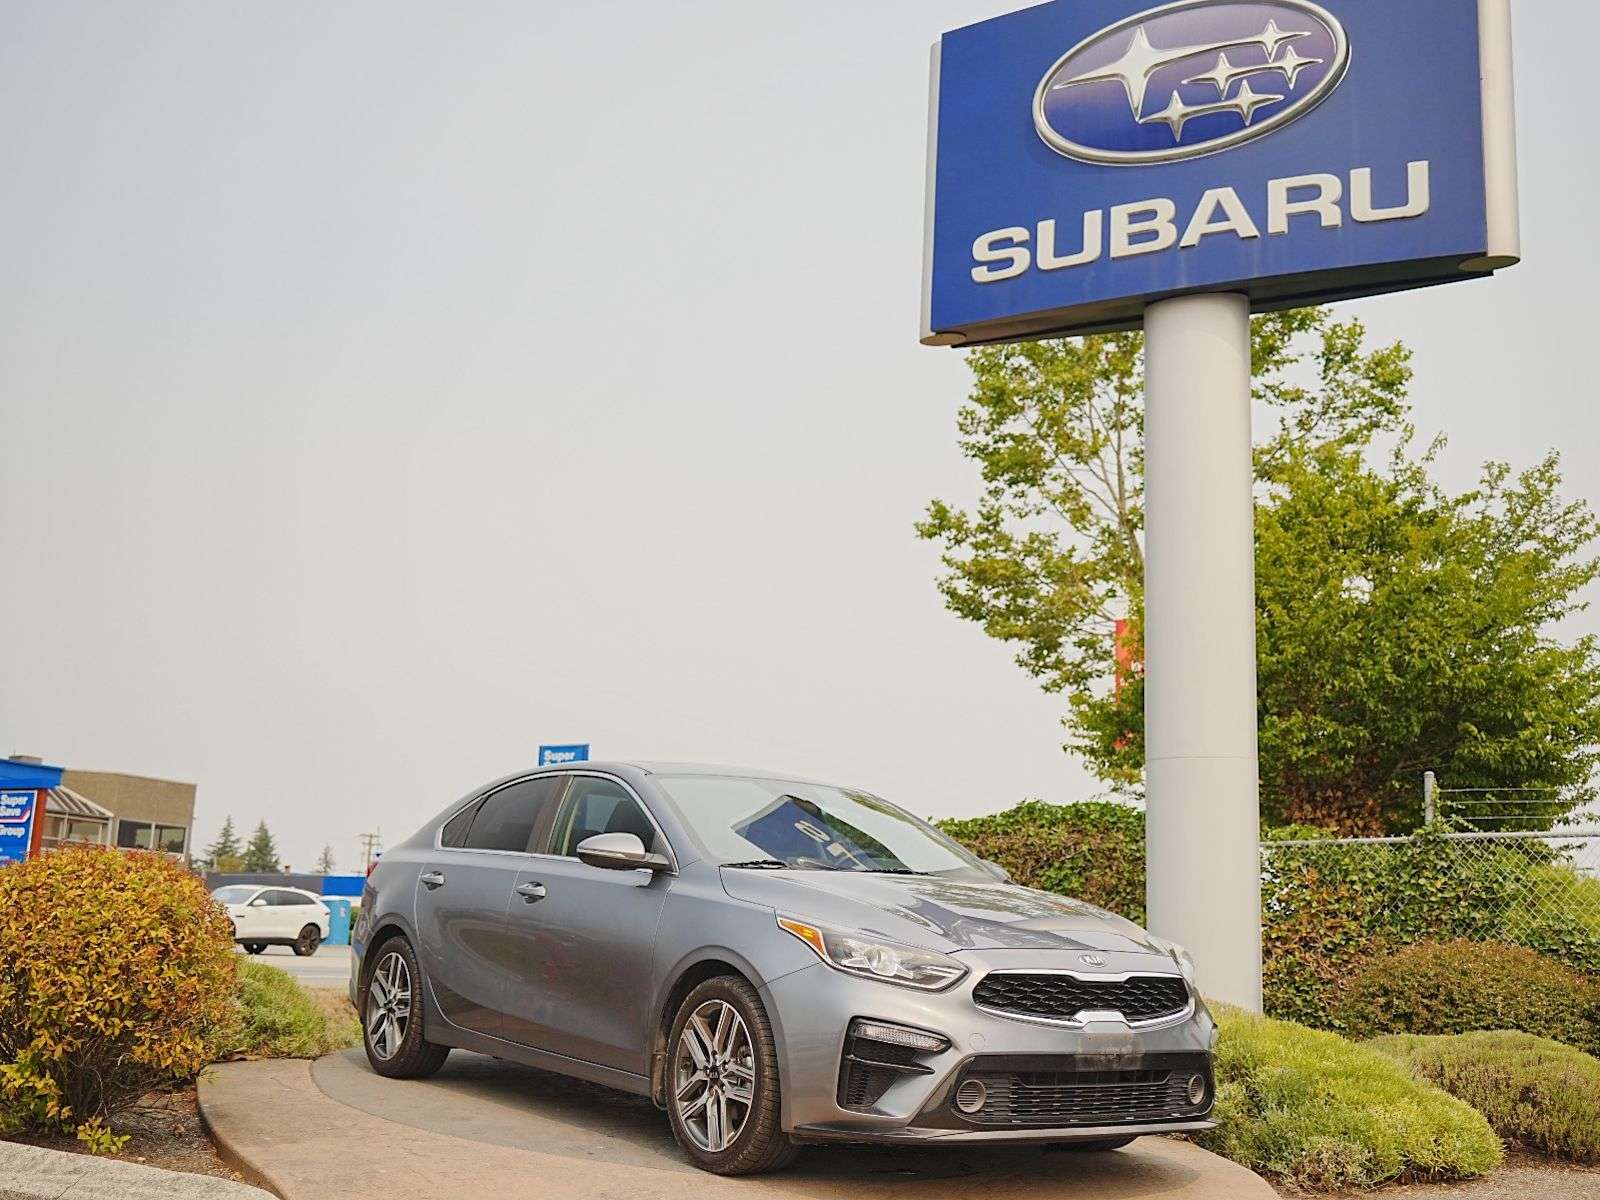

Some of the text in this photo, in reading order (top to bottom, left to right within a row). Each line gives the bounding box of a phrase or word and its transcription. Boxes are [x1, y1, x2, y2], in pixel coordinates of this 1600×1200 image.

[971, 160, 1430, 283] SUBARU
[544, 750, 575, 763] Super
[1, 794, 28, 806] Super
[0, 806, 21, 816] Save
